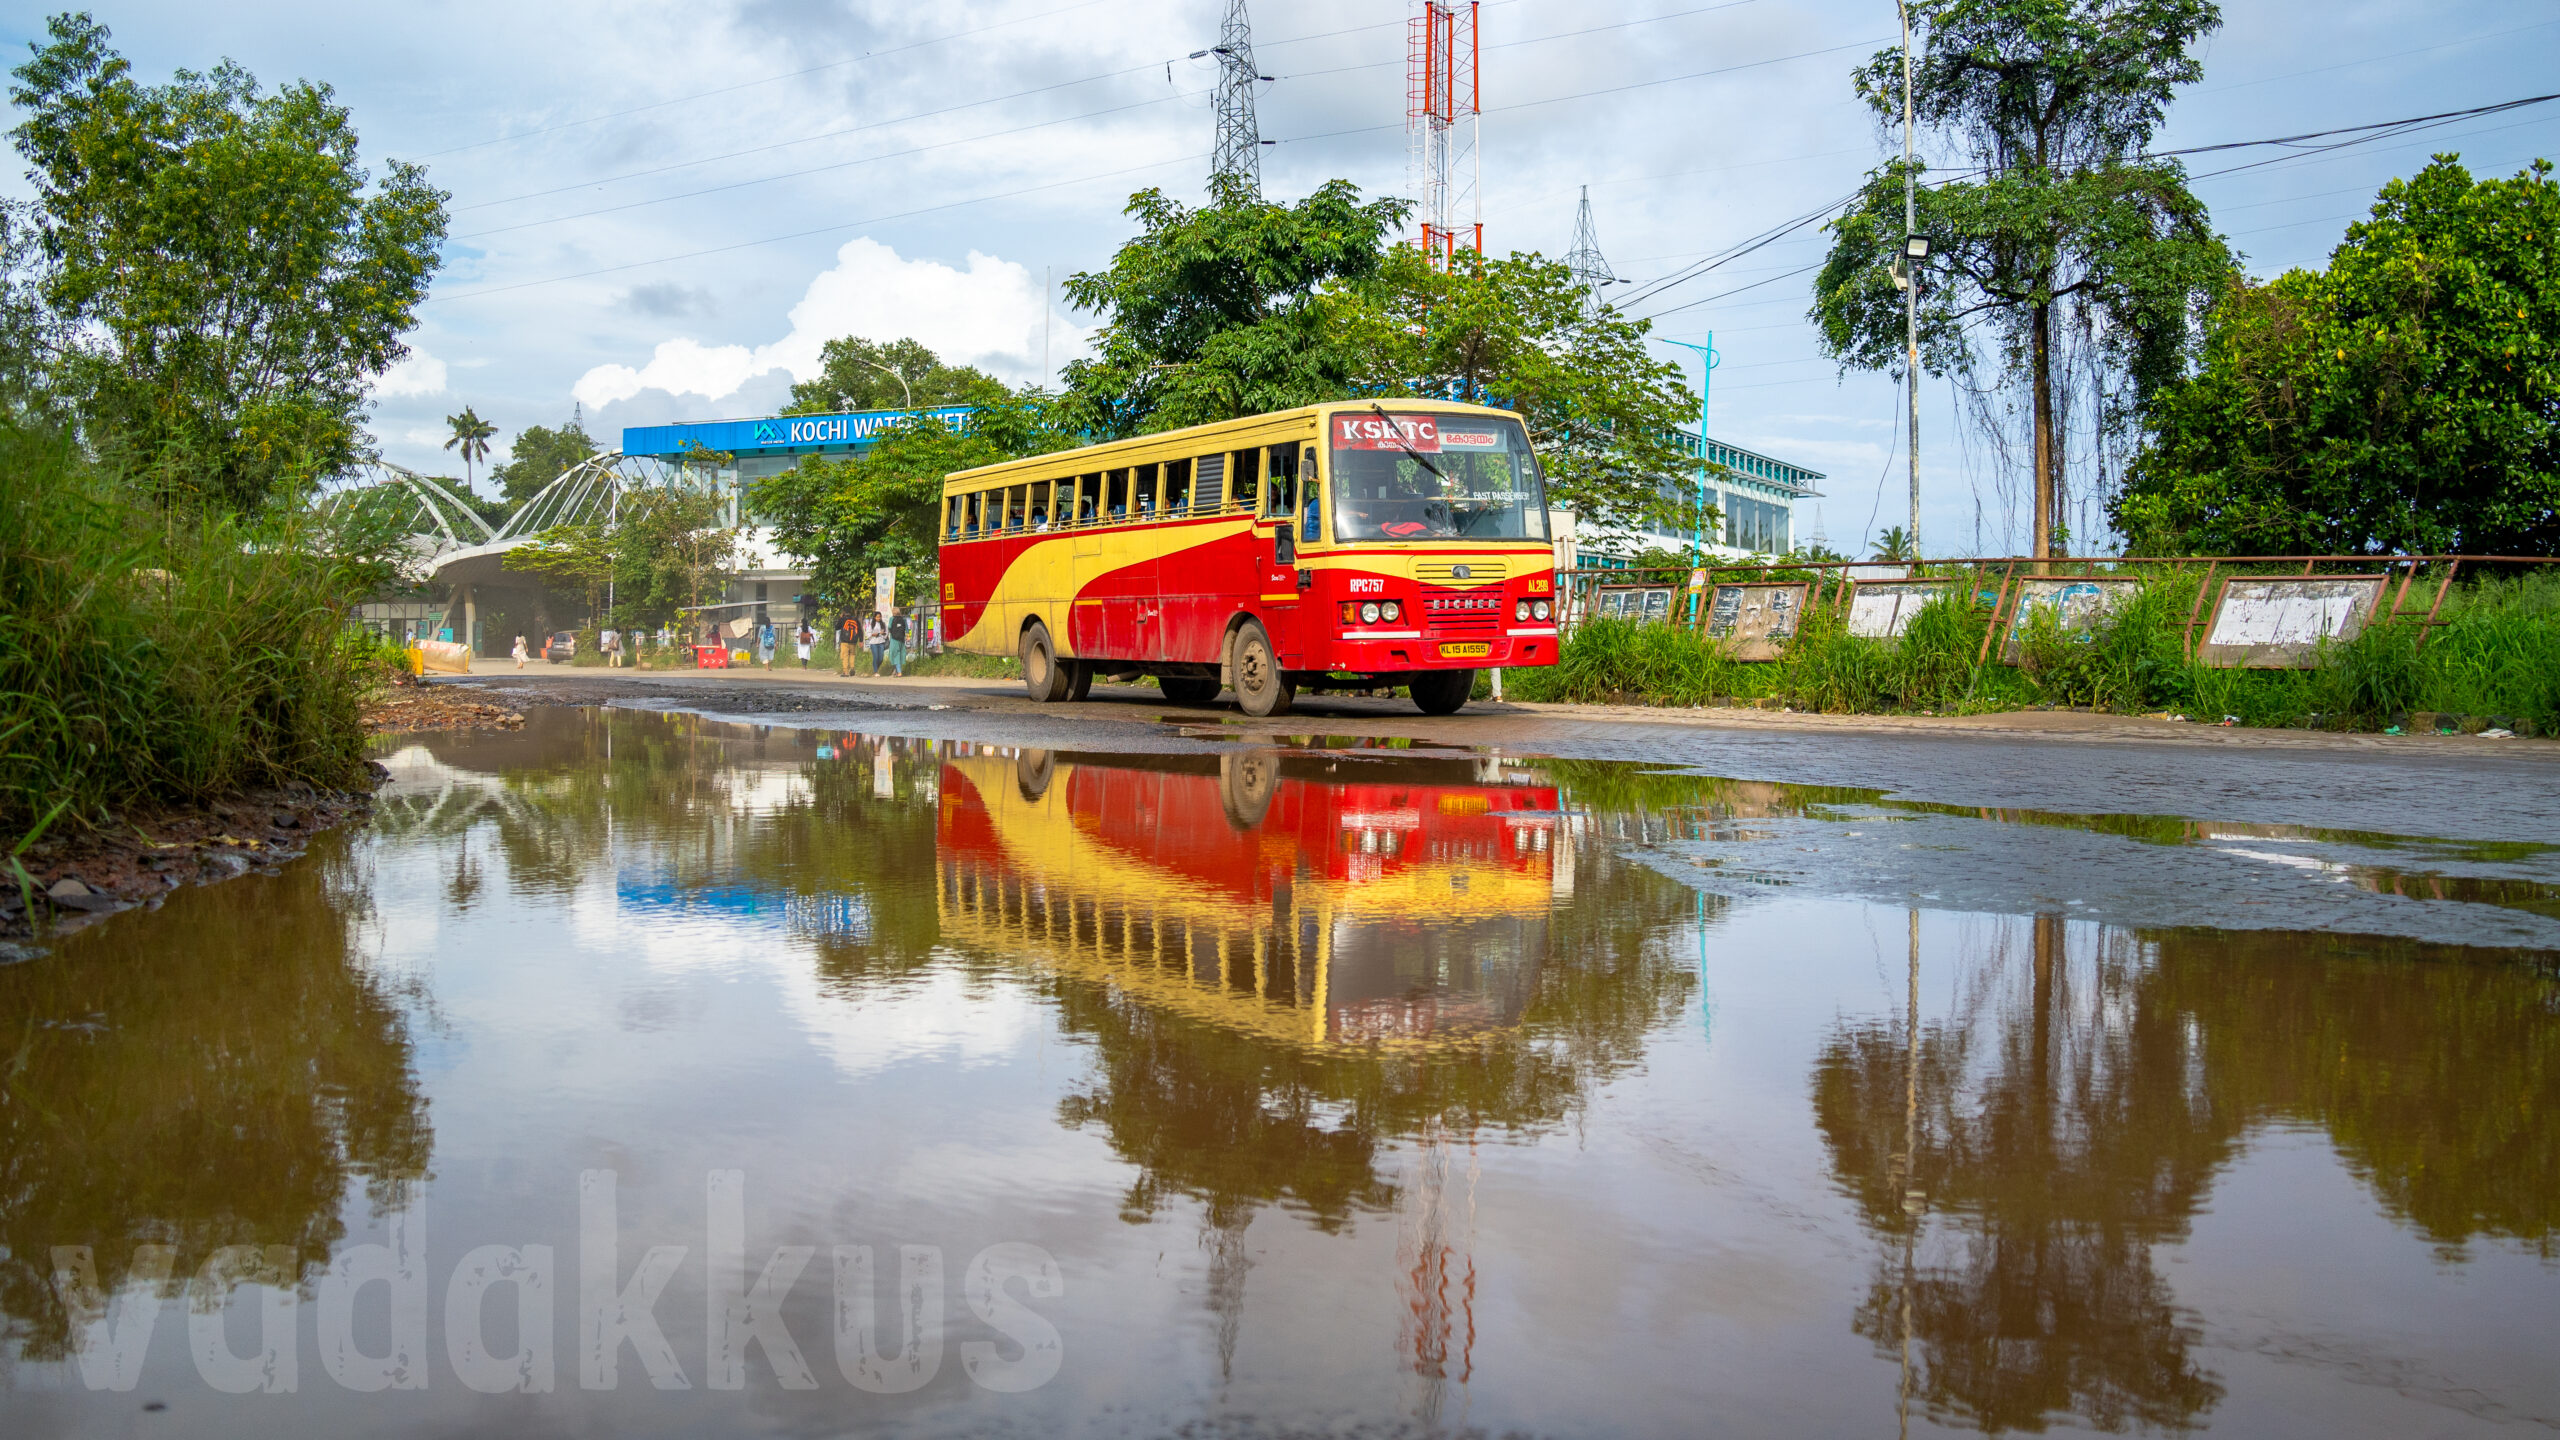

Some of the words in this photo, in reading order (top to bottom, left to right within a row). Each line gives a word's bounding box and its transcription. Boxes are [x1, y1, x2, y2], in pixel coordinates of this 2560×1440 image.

[791, 420, 847, 442] KOCHI
[1342, 420, 1435, 440] KSRTC
[1446, 434, 1494, 445] കോട്ടയം
[1473, 491, 1490, 500] FAST
[1350, 578, 1384, 593] RPC757
[1433, 599, 1496, 610] EICHER
[1453, 645, 1461, 654] 15
